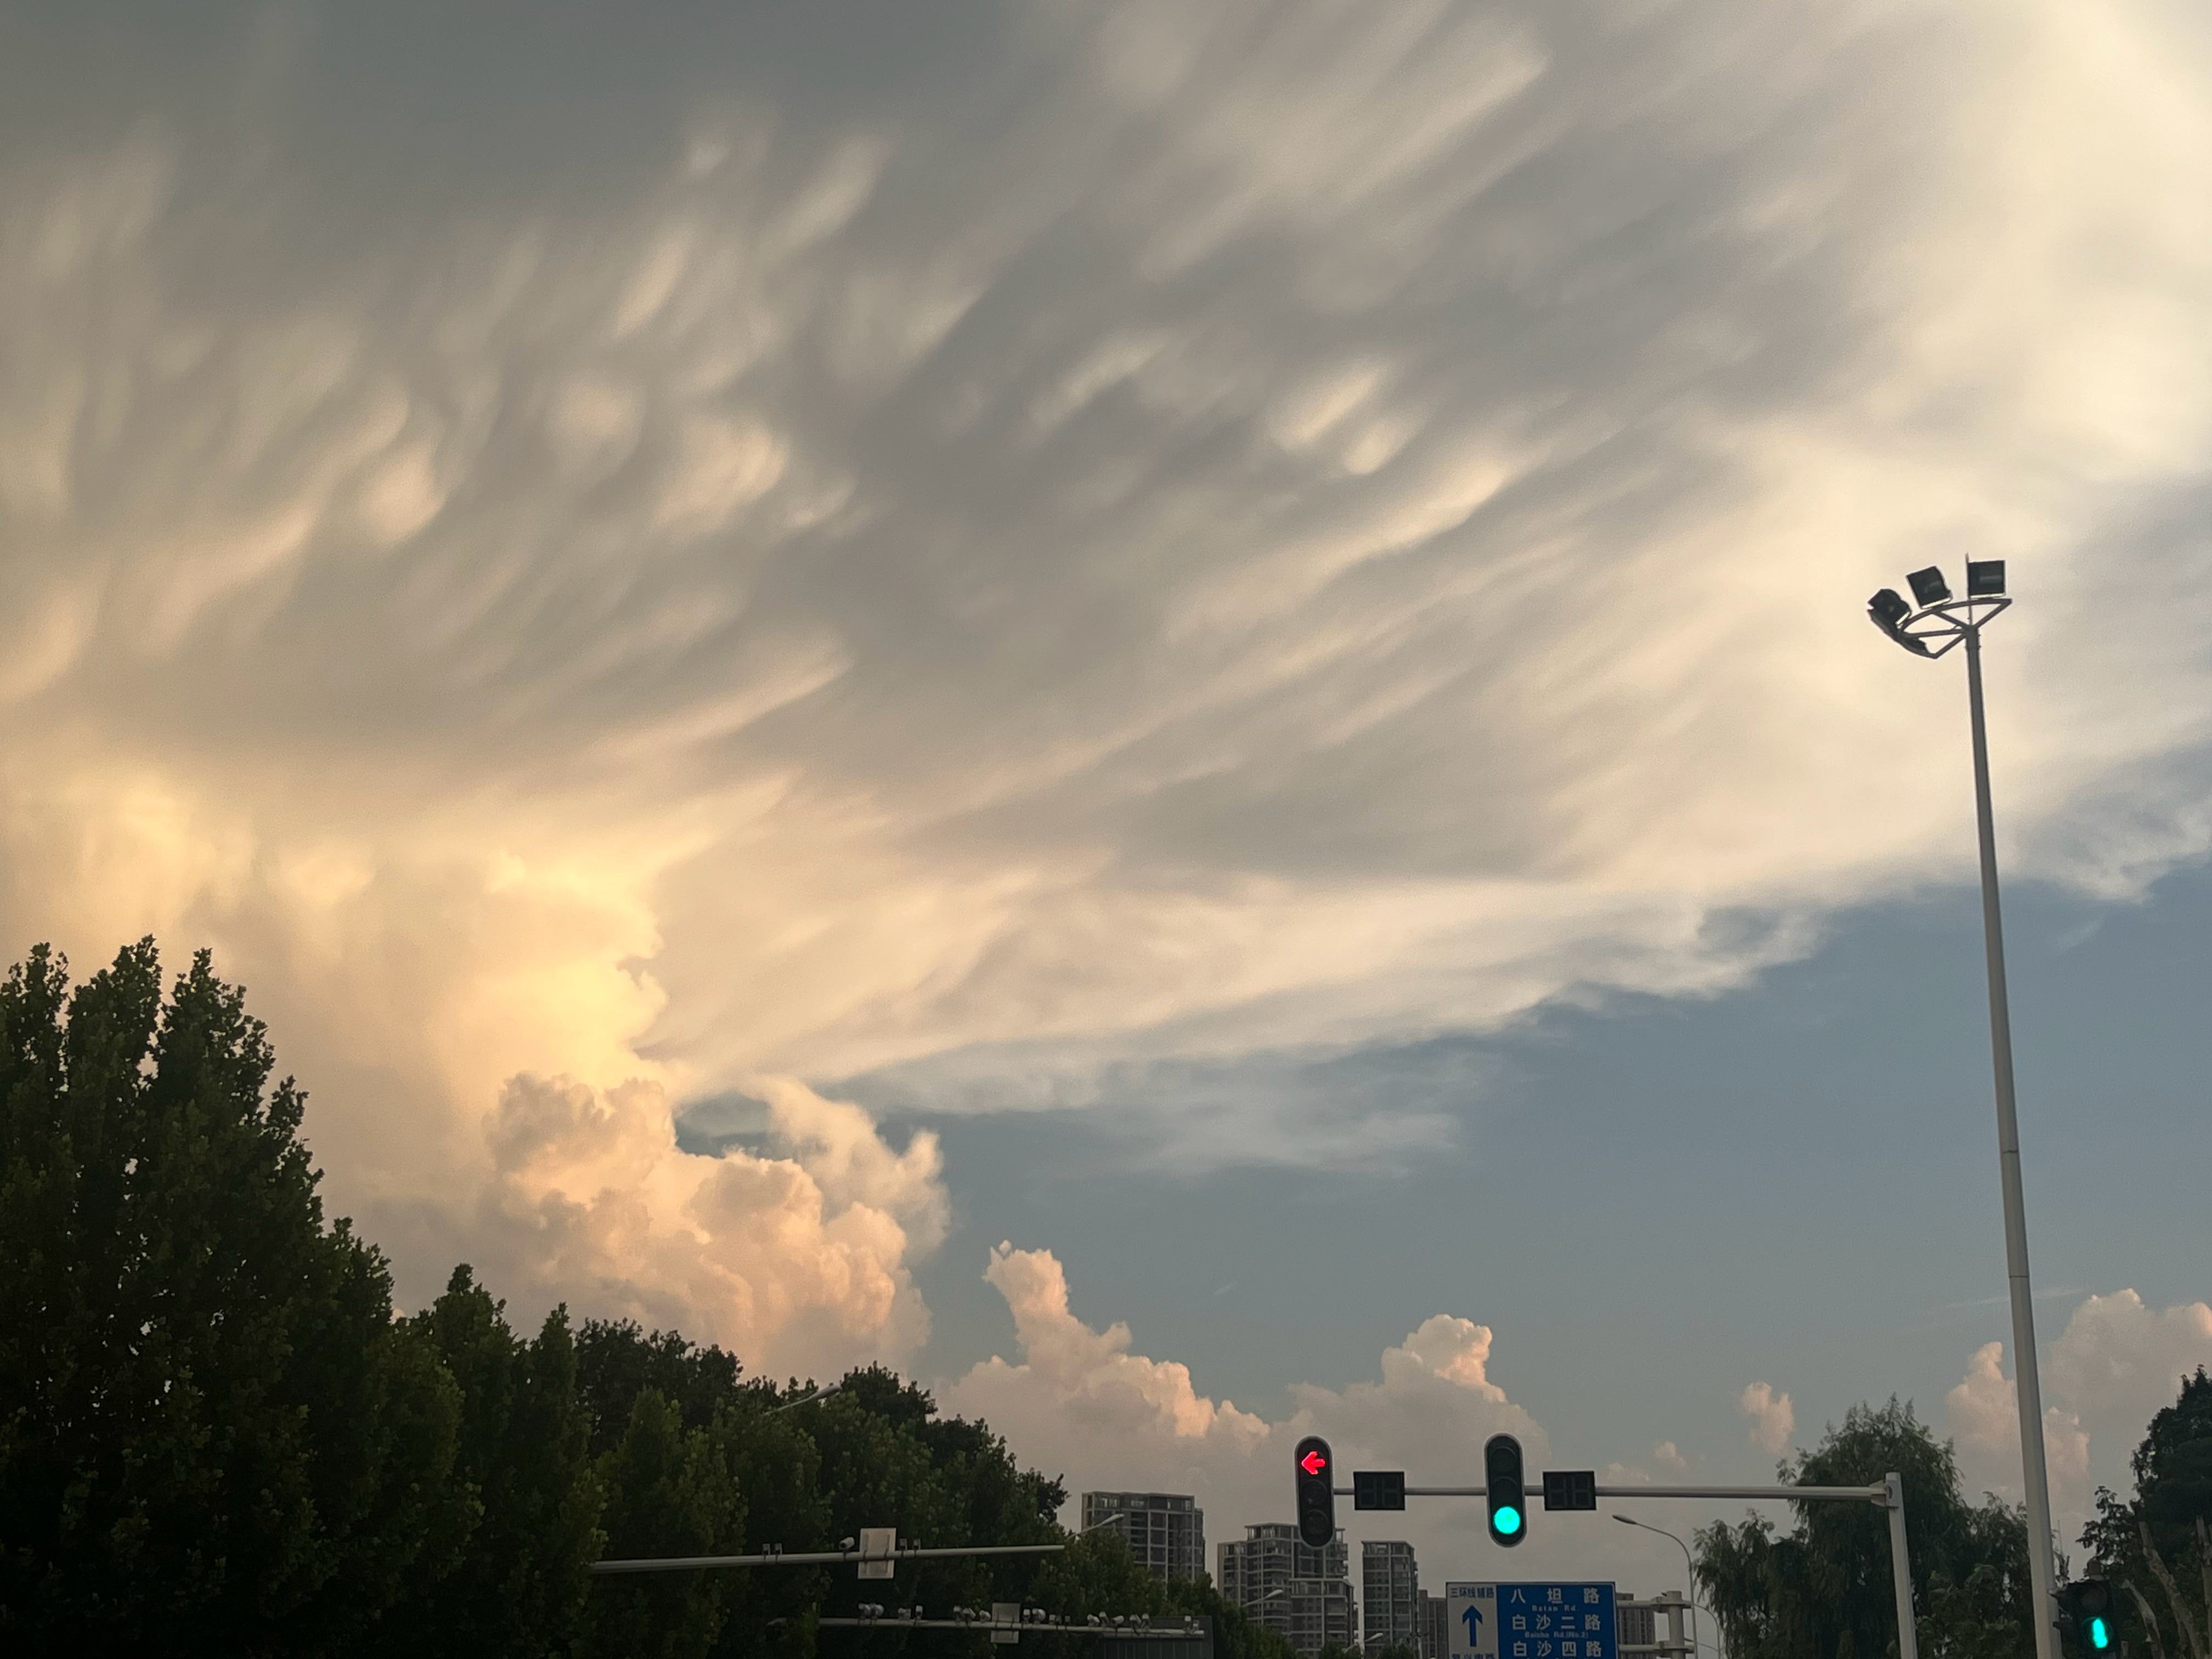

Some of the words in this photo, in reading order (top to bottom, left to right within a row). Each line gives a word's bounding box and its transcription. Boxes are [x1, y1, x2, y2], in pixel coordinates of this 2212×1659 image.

[1510, 1588, 1600, 1604] 八坦路
[1512, 1614, 1600, 1630] 白沙二路
[1513, 1640, 1601, 1657] 白沙四路
